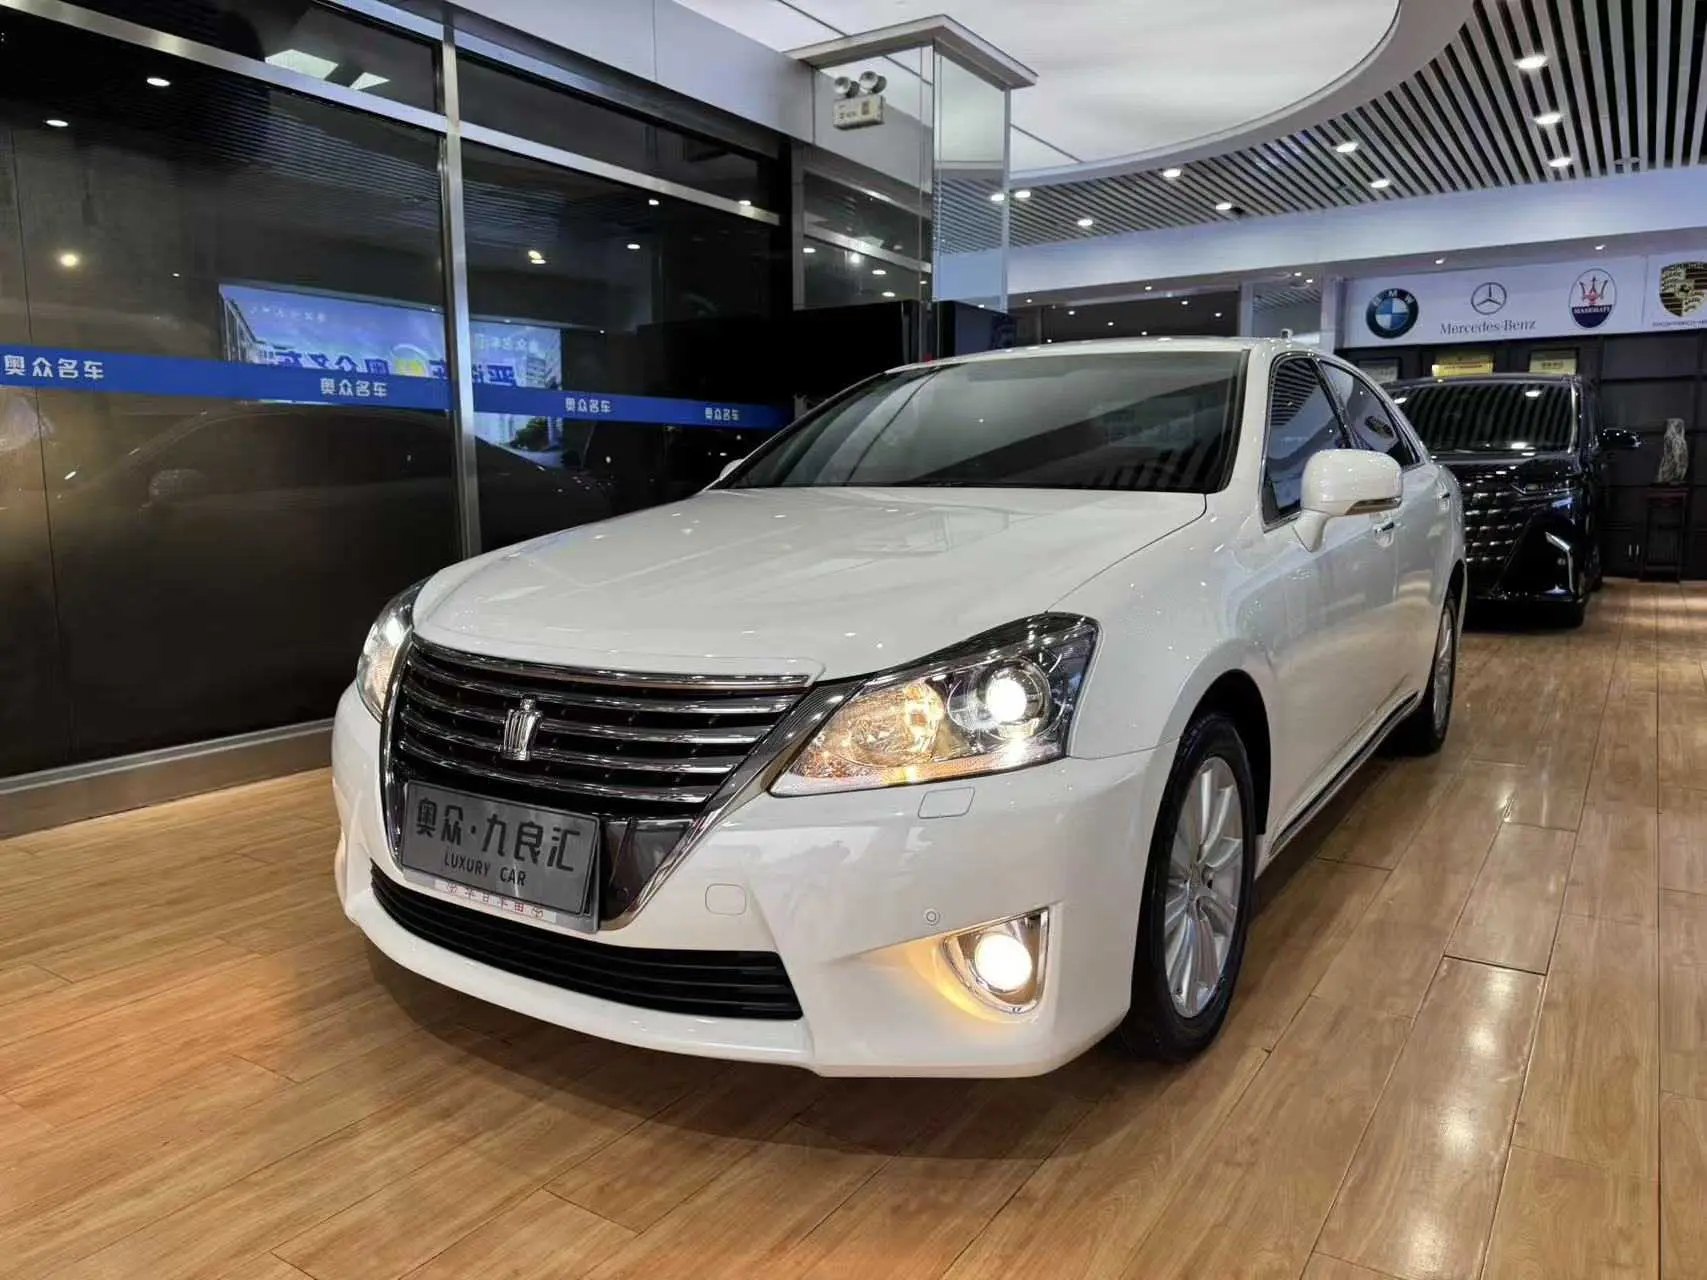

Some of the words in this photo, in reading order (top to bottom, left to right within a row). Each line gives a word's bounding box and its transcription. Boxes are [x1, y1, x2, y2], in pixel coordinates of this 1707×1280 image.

[1440, 319, 1537, 335] Mercedes-Benz
[4, 354, 104, 380] 奥众名车
[320, 377, 387, 398] 奥众名车
[565, 397, 612, 414] 奥众名车
[705, 407, 740, 421] 奥众名车
[444, 851, 491, 877] LUXURY
[500, 866, 527, 886] CAR
